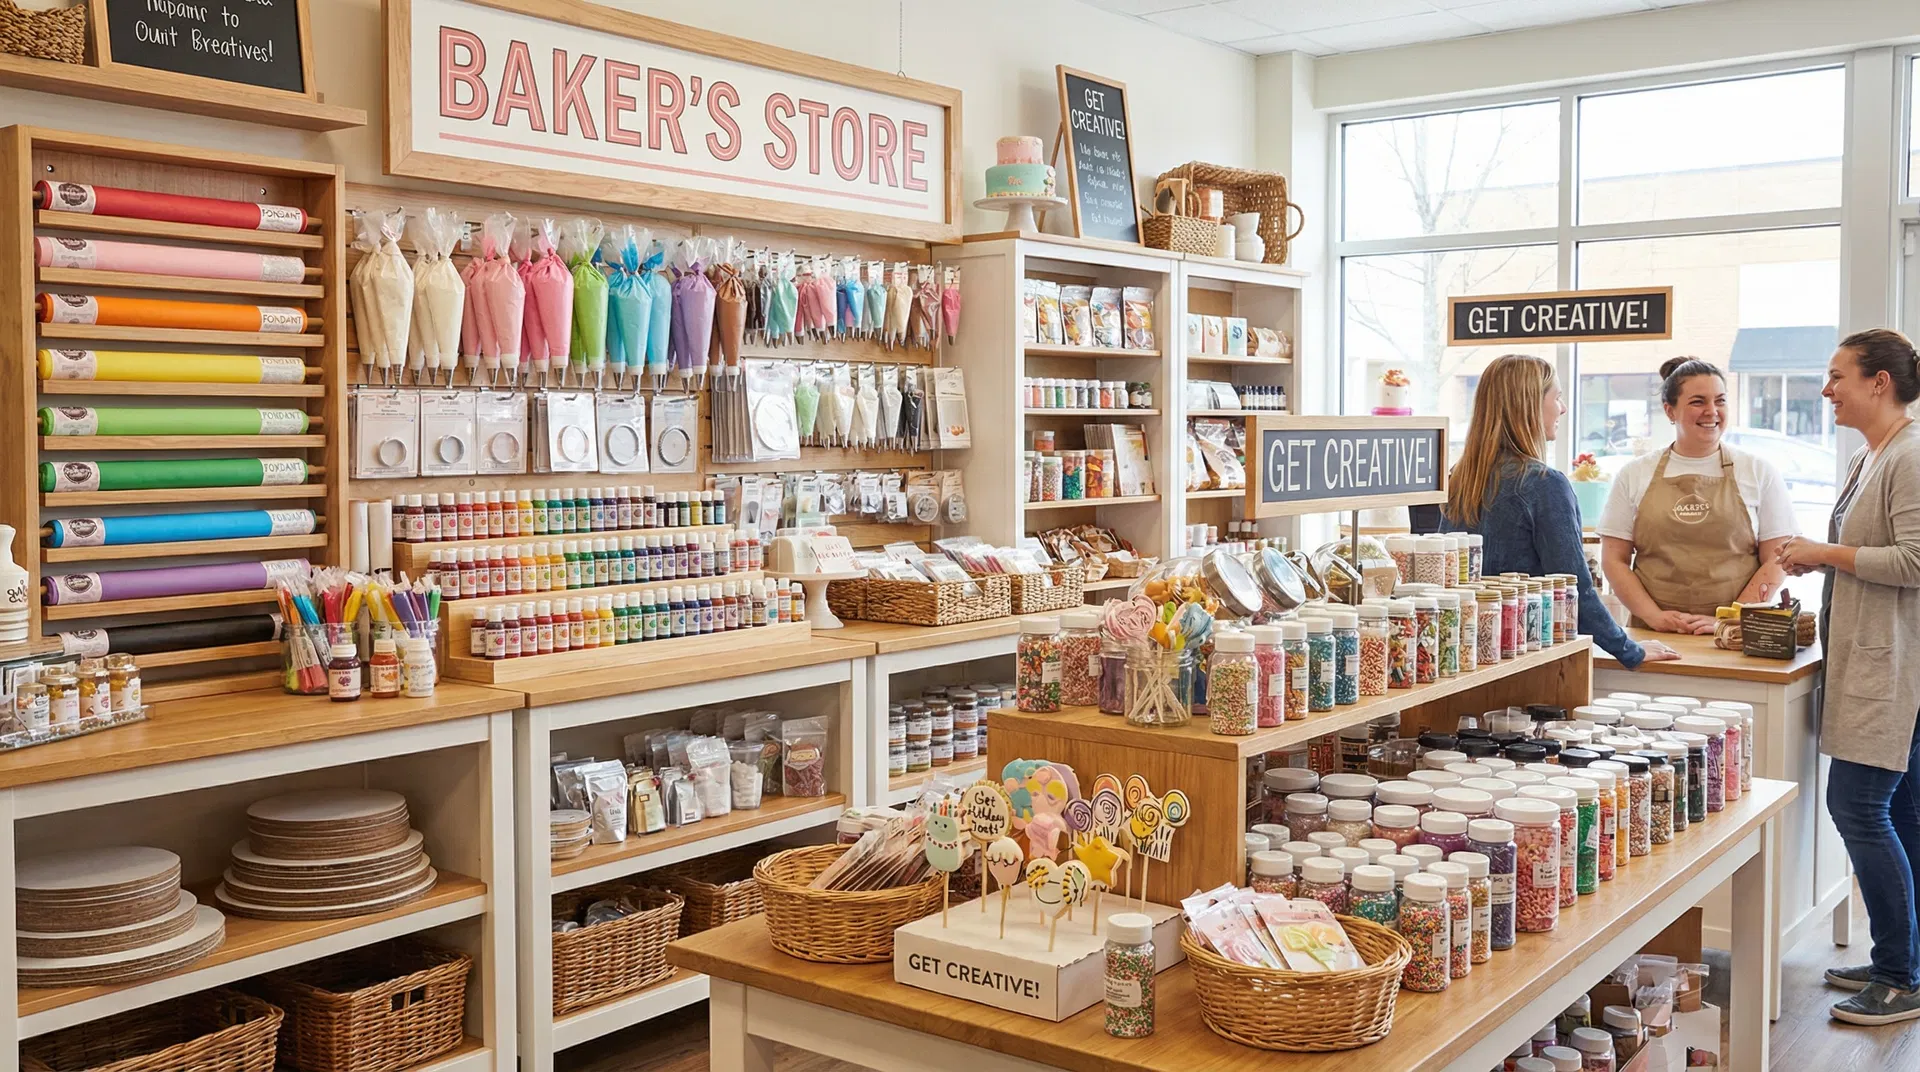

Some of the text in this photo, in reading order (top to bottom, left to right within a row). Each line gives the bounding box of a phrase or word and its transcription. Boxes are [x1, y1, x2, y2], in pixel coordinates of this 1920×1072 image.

[221, 6, 240, 28] to
[191, 28, 274, 62] Breatives!
[439, 25, 928, 193] BAKER'S STORE
[1085, 88, 1105, 112] GET
[1071, 110, 1126, 140] CREATIVE!
[263, 314, 302, 324] FONDANT
[1468, 301, 1649, 334] GET CREATIVE!
[1268, 437, 1433, 492] GET CREATIVE!
[974, 790, 996, 807] Get
[908, 953, 1040, 999] GET CREATIVE!
